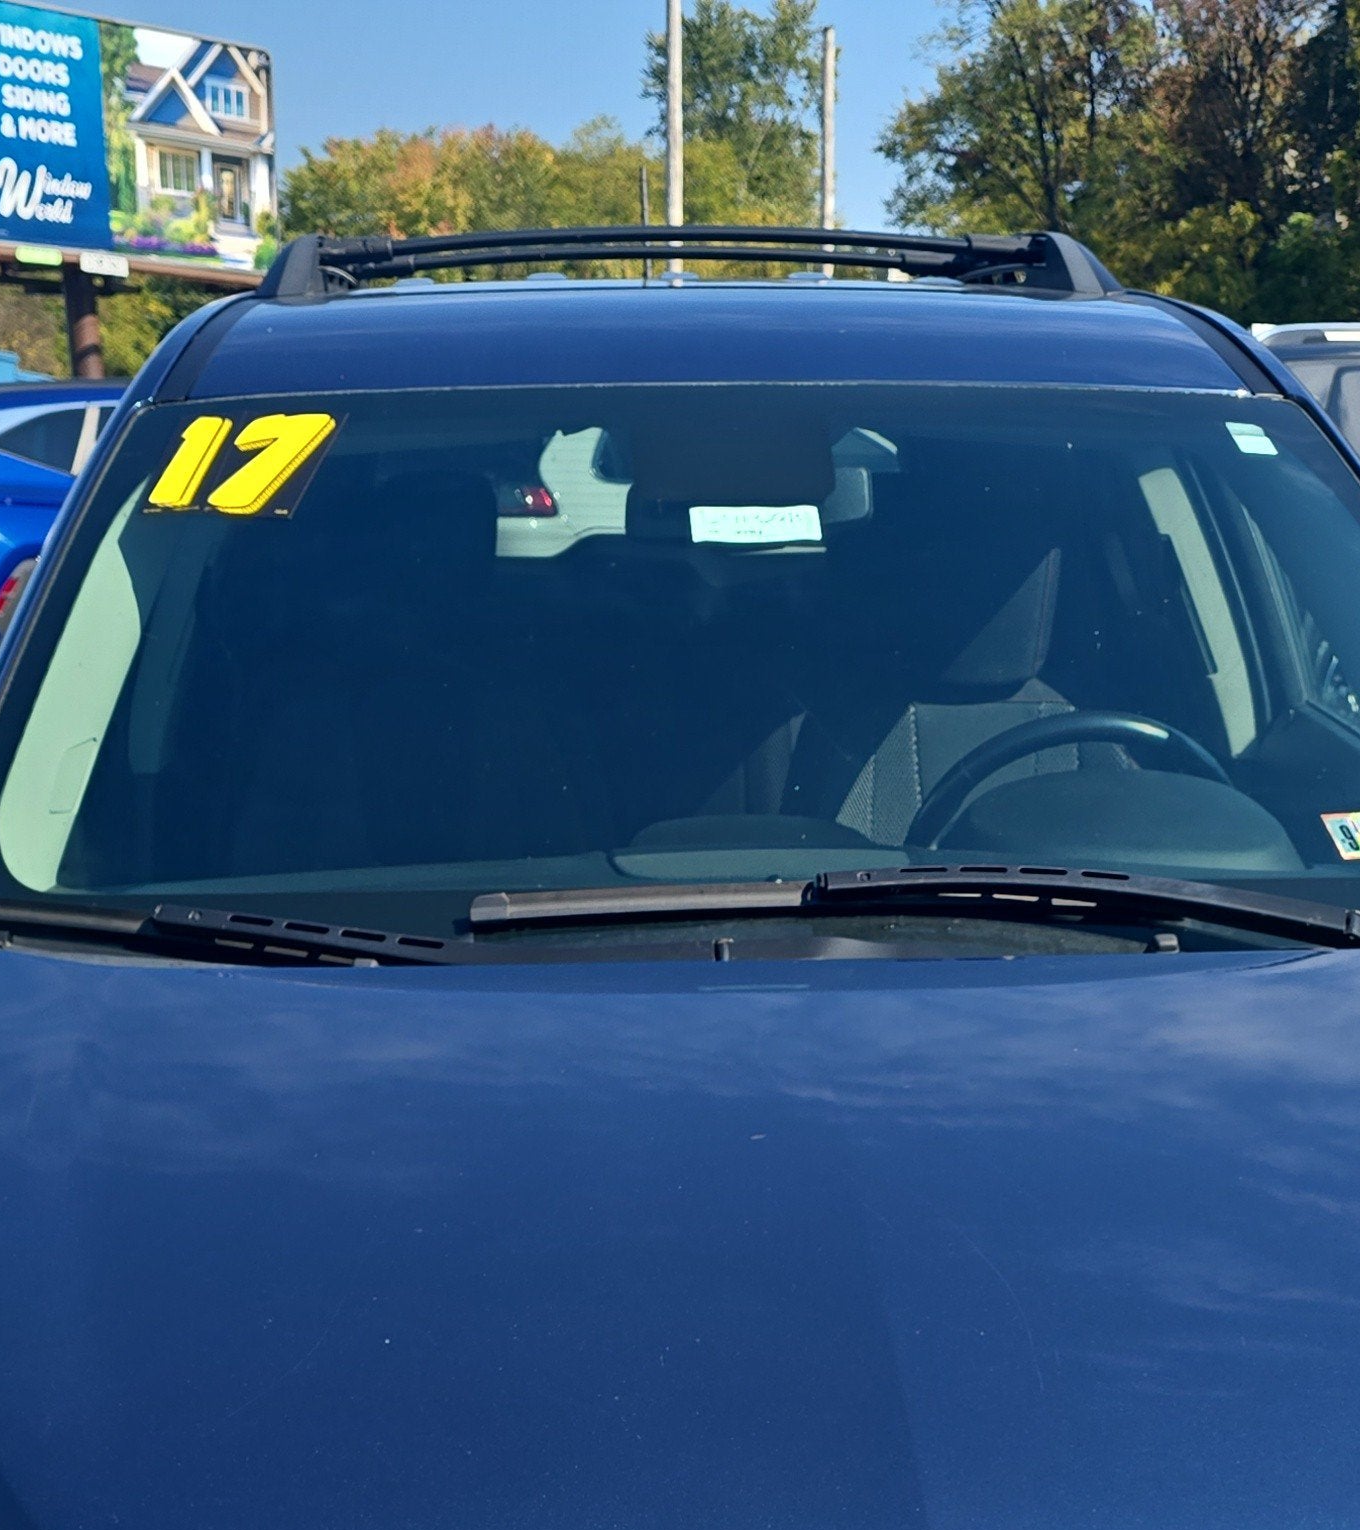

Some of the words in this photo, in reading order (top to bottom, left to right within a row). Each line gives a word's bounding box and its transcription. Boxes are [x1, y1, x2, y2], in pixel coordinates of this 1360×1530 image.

[1, 84, 71, 117] SIDING
[0, 113, 17, 139] &
[17, 117, 78, 147] MORE
[147, 412, 337, 516] 17
